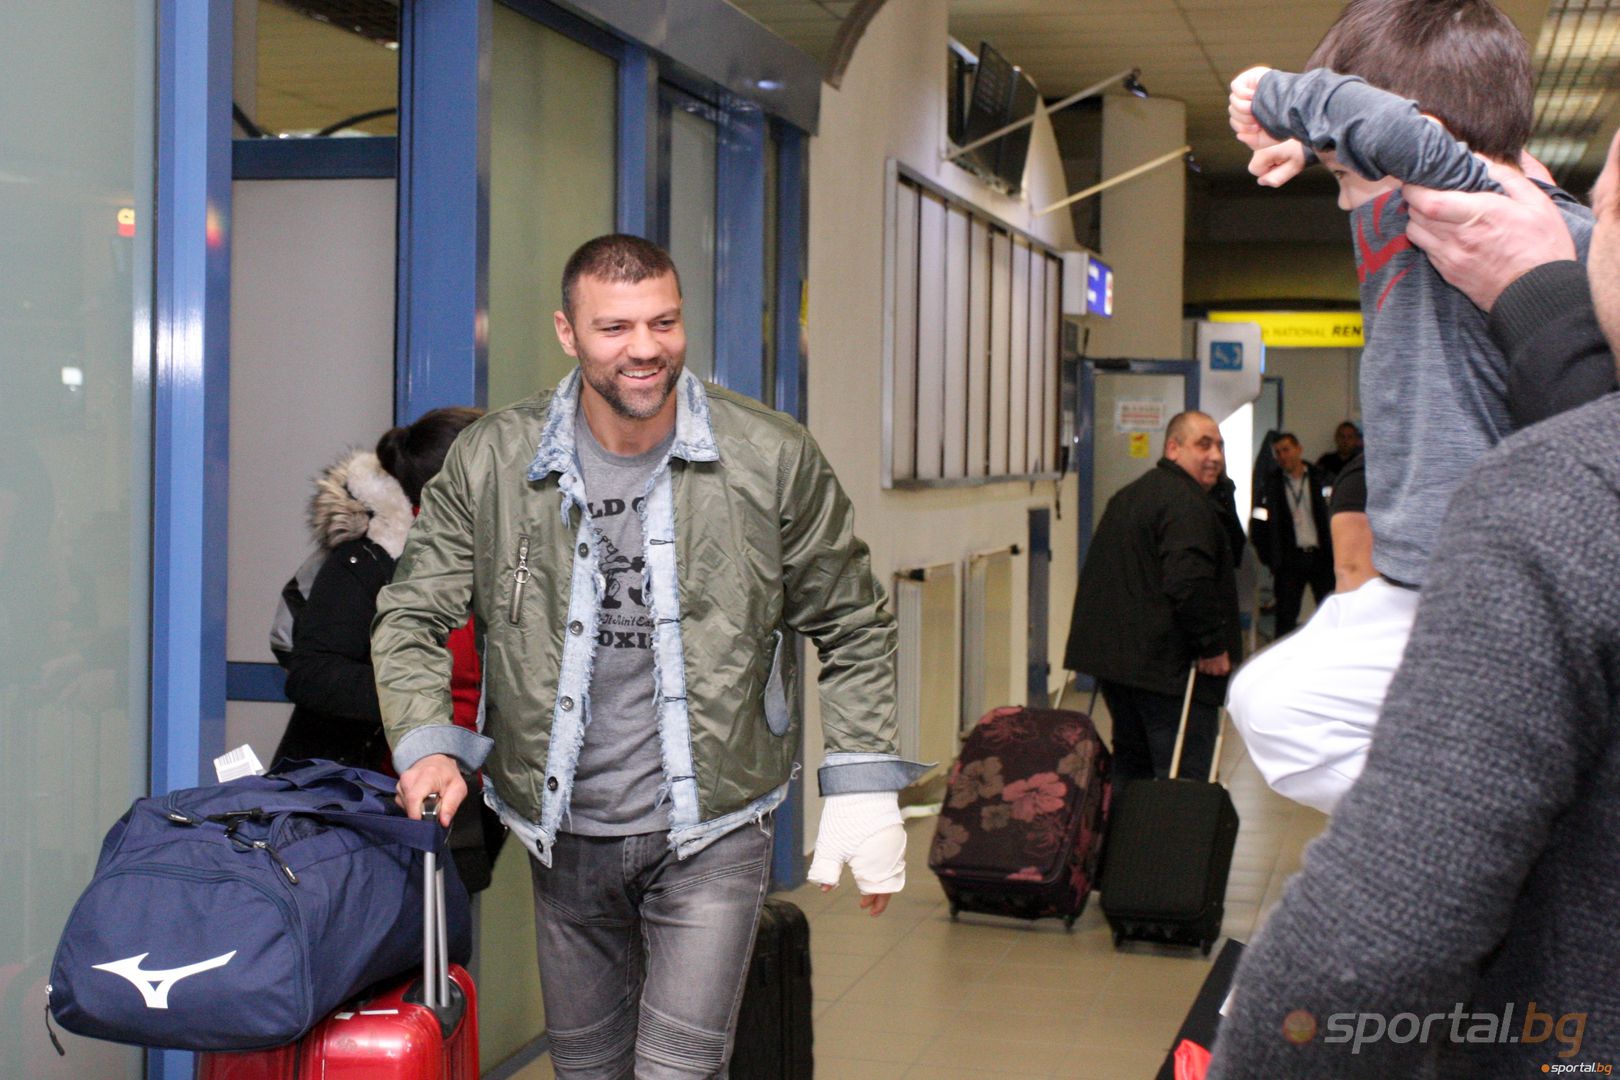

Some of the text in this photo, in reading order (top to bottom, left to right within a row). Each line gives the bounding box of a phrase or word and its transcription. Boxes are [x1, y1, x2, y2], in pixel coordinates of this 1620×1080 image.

[1332, 325, 1363, 337] REN
[587, 499, 626, 519] LD
[598, 630, 653, 649] OXI
